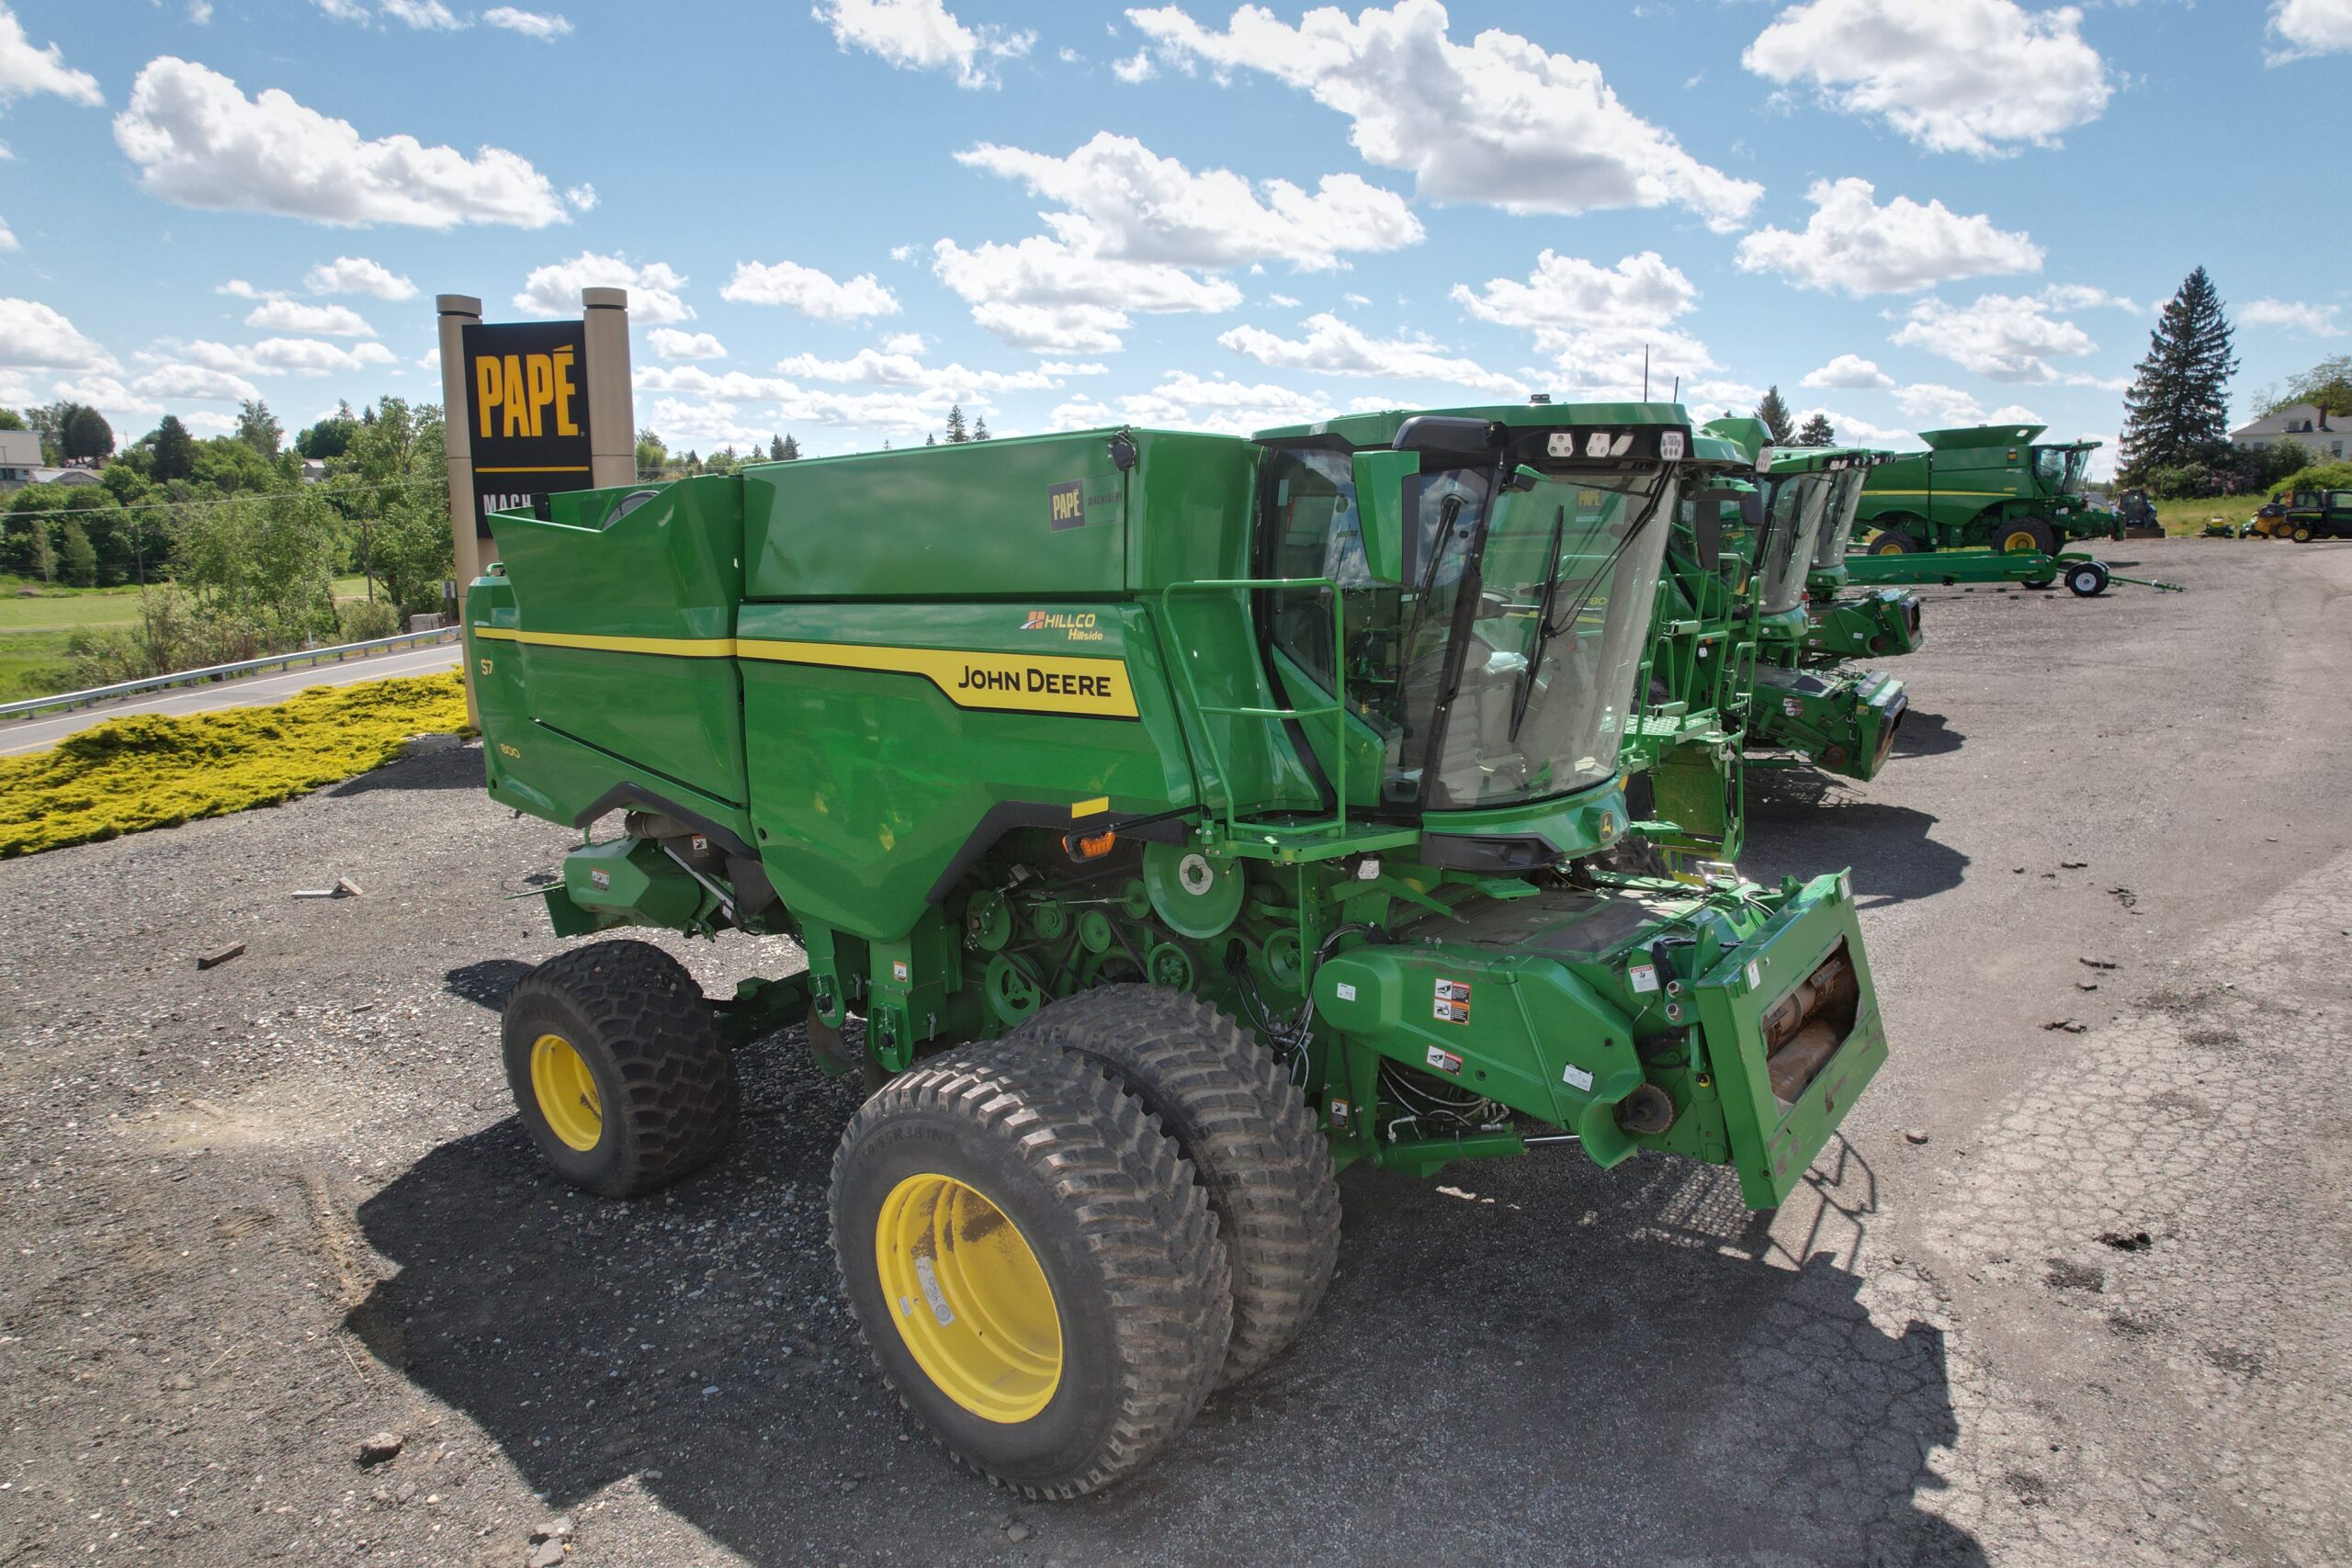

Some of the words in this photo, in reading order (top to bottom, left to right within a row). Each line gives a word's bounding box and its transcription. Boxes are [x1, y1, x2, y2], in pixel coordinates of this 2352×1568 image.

[476, 344, 579, 437] PAPÉ
[1053, 489, 1080, 521] PAPÉ
[1044, 614, 1096, 628] HILLCO
[1068, 628, 1103, 640] Hillside
[958, 665, 1021, 691] JOHN
[1027, 668, 1112, 697] DEERE
